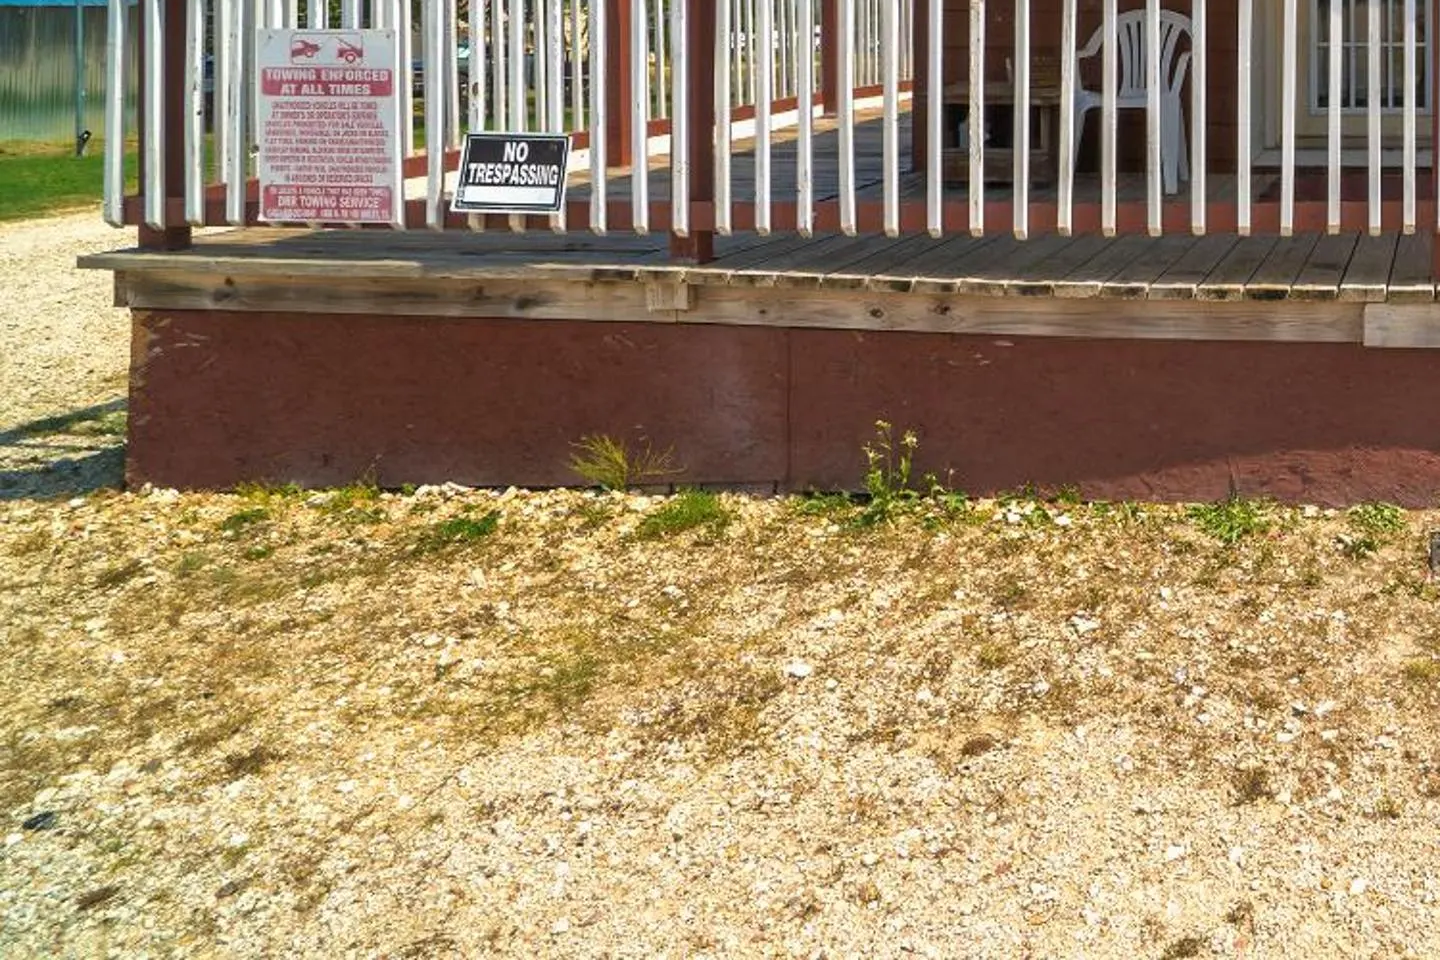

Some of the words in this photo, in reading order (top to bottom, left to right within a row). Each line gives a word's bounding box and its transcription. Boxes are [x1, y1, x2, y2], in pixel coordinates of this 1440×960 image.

[265, 68, 317, 81] TOWING
[320, 68, 390, 82] ENFORCED
[281, 83, 298, 96] AT
[301, 83, 326, 96] ALL
[328, 83, 373, 96] TIMES
[502, 141, 530, 163] NO
[467, 162, 560, 186] TRESPASSING
[299, 196, 338, 209] TOWING
